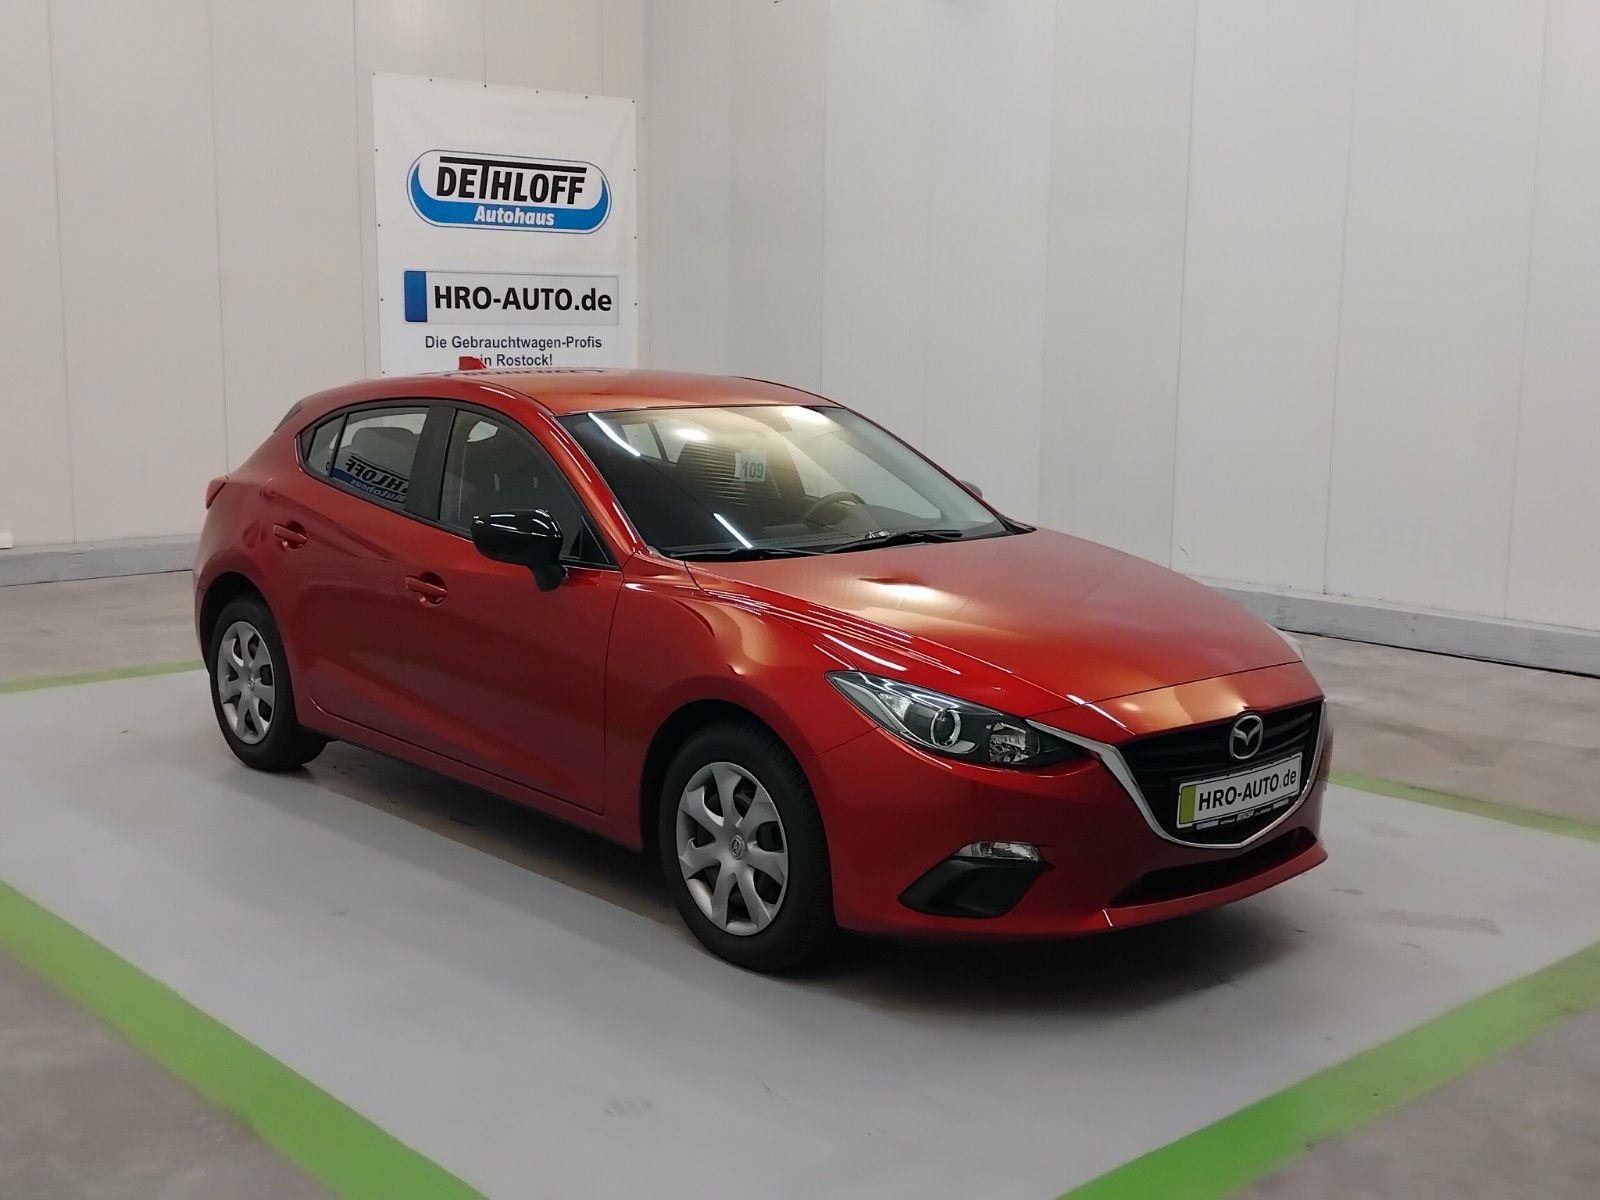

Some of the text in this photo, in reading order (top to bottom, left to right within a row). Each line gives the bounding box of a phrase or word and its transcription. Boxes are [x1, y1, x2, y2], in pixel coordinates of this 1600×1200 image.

[436, 156, 587, 205] DETHLOFF
[474, 205, 555, 226] Autohaus
[434, 285, 612, 312] HRO-AUTO.de
[425, 336, 602, 352] Die Gebrauchtwagen-Profis
[496, 354, 553, 367] Rostock!
[742, 461, 763, 479] 109
